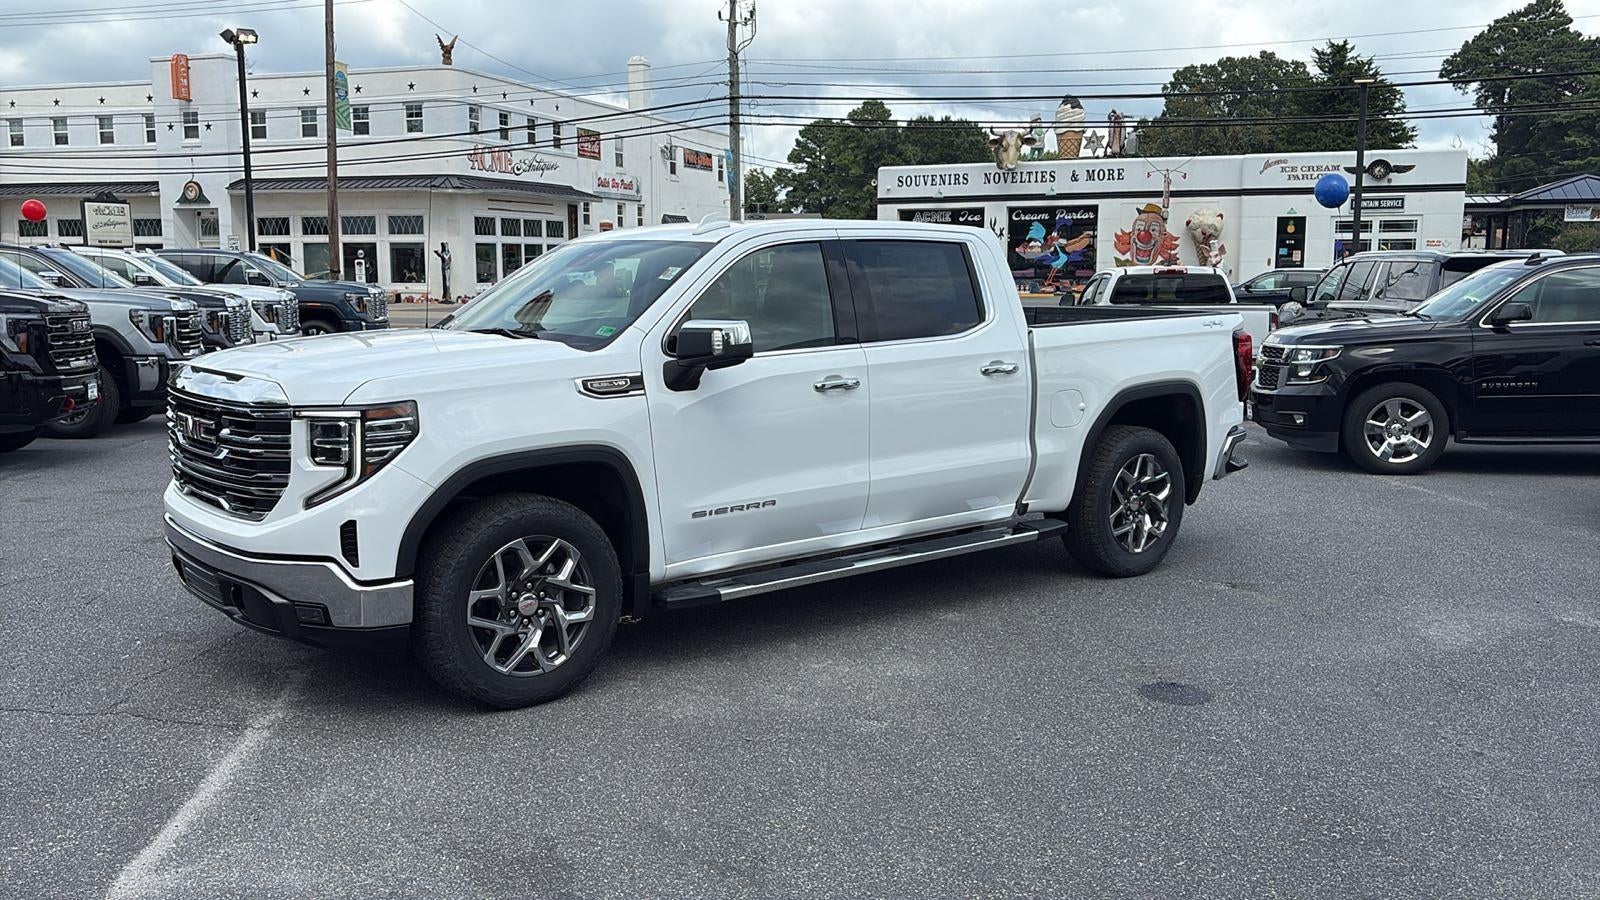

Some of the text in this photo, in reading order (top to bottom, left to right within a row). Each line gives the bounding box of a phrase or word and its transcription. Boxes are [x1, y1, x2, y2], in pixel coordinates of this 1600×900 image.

[468, 144, 560, 178] ACME Antiques
[1259, 159, 1289, 175] Acme
[1280, 164, 1341, 173] ICE CREAM
[897, 168, 1125, 188] SOUVENIRS NOVELTIES & MORE
[1286, 172, 1328, 181] PARLO
[1380, 200, 1403, 208] SERVICE
[912, 210, 983, 223] ACME Ice
[1012, 208, 1096, 221] Cream Parlor
[1481, 381, 1539, 389] SUBURBAN
[691, 499, 777, 519] SIERRA
